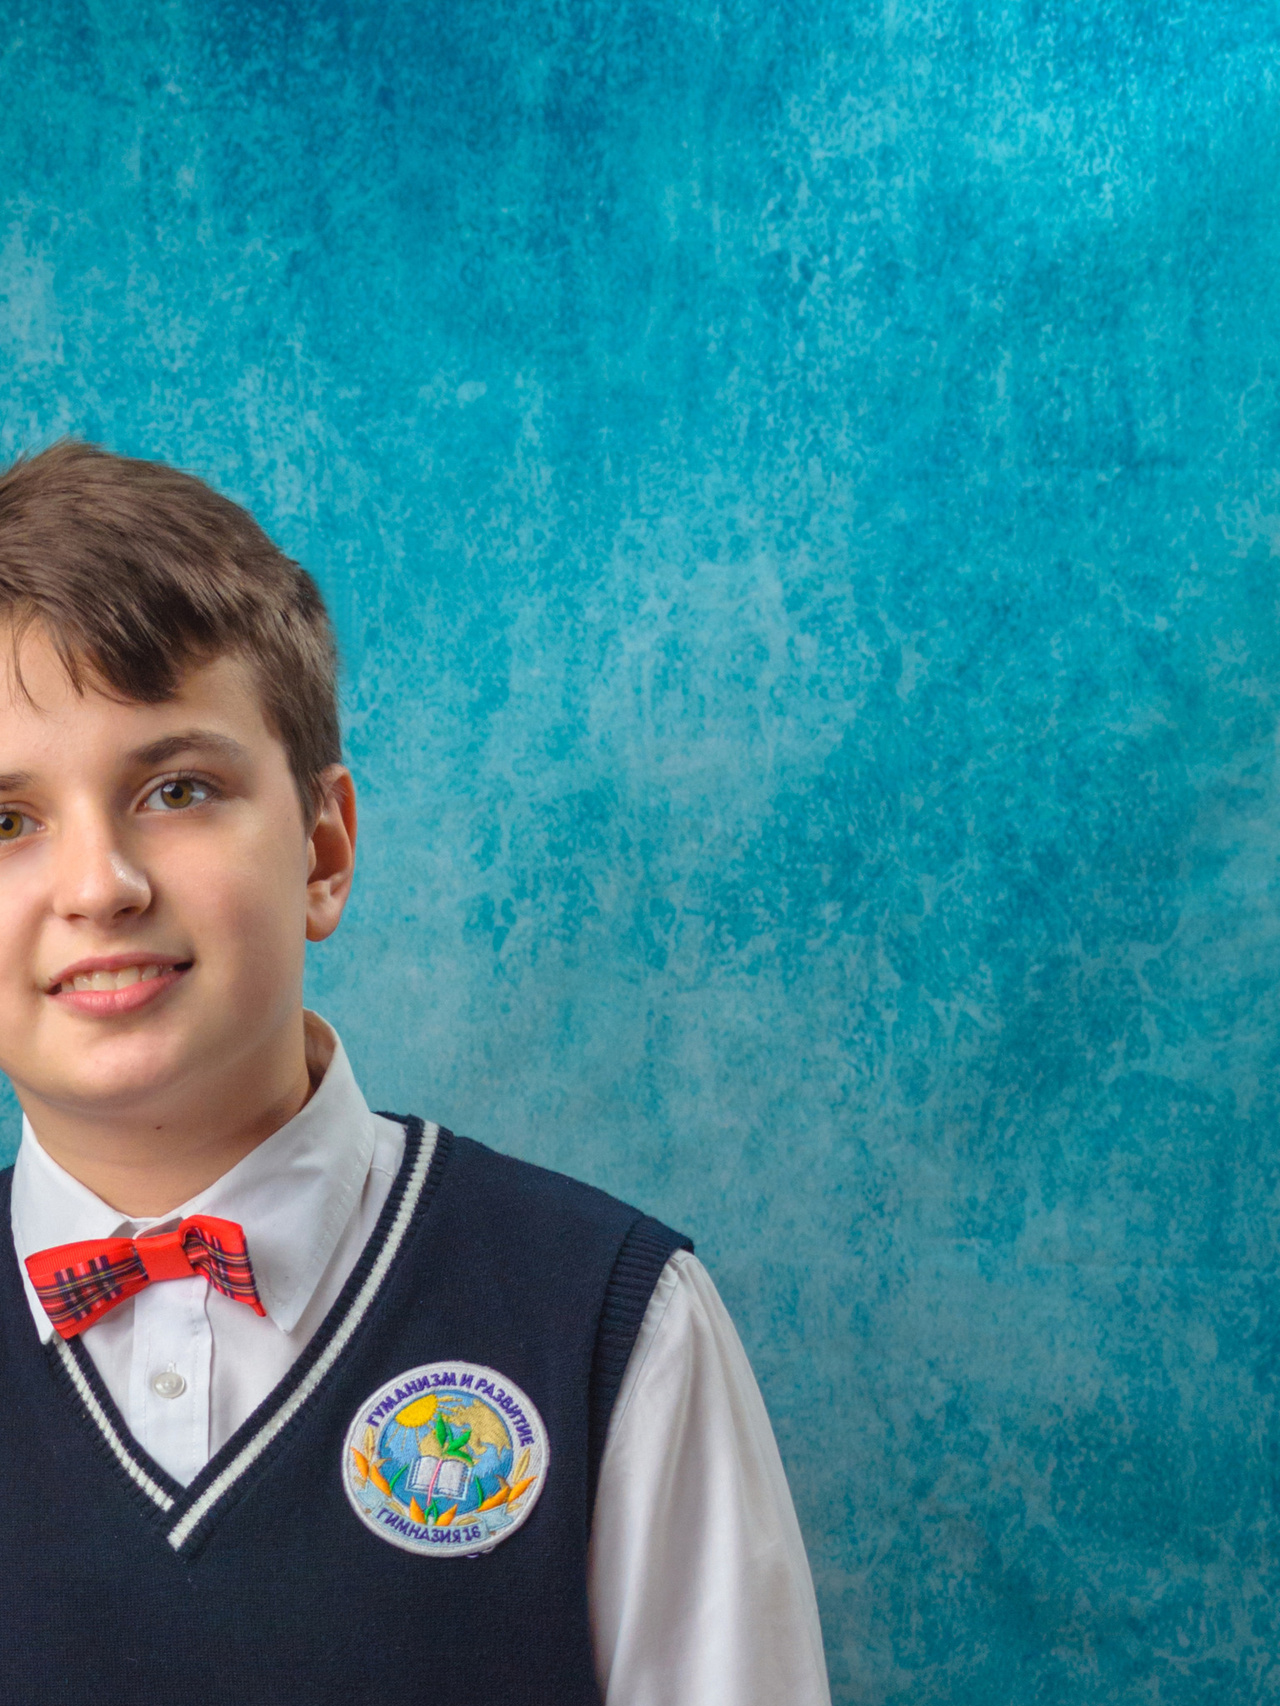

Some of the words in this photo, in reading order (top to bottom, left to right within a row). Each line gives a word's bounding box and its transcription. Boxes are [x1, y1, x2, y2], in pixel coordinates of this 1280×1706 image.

[366, 1371, 457, 1428] ГУМАНИЗМ
[460, 1373, 474, 1388] И
[474, 1377, 535, 1448] РАЗВИТИЕ
[376, 1508, 462, 1543] ГИМНАЗИЯ
